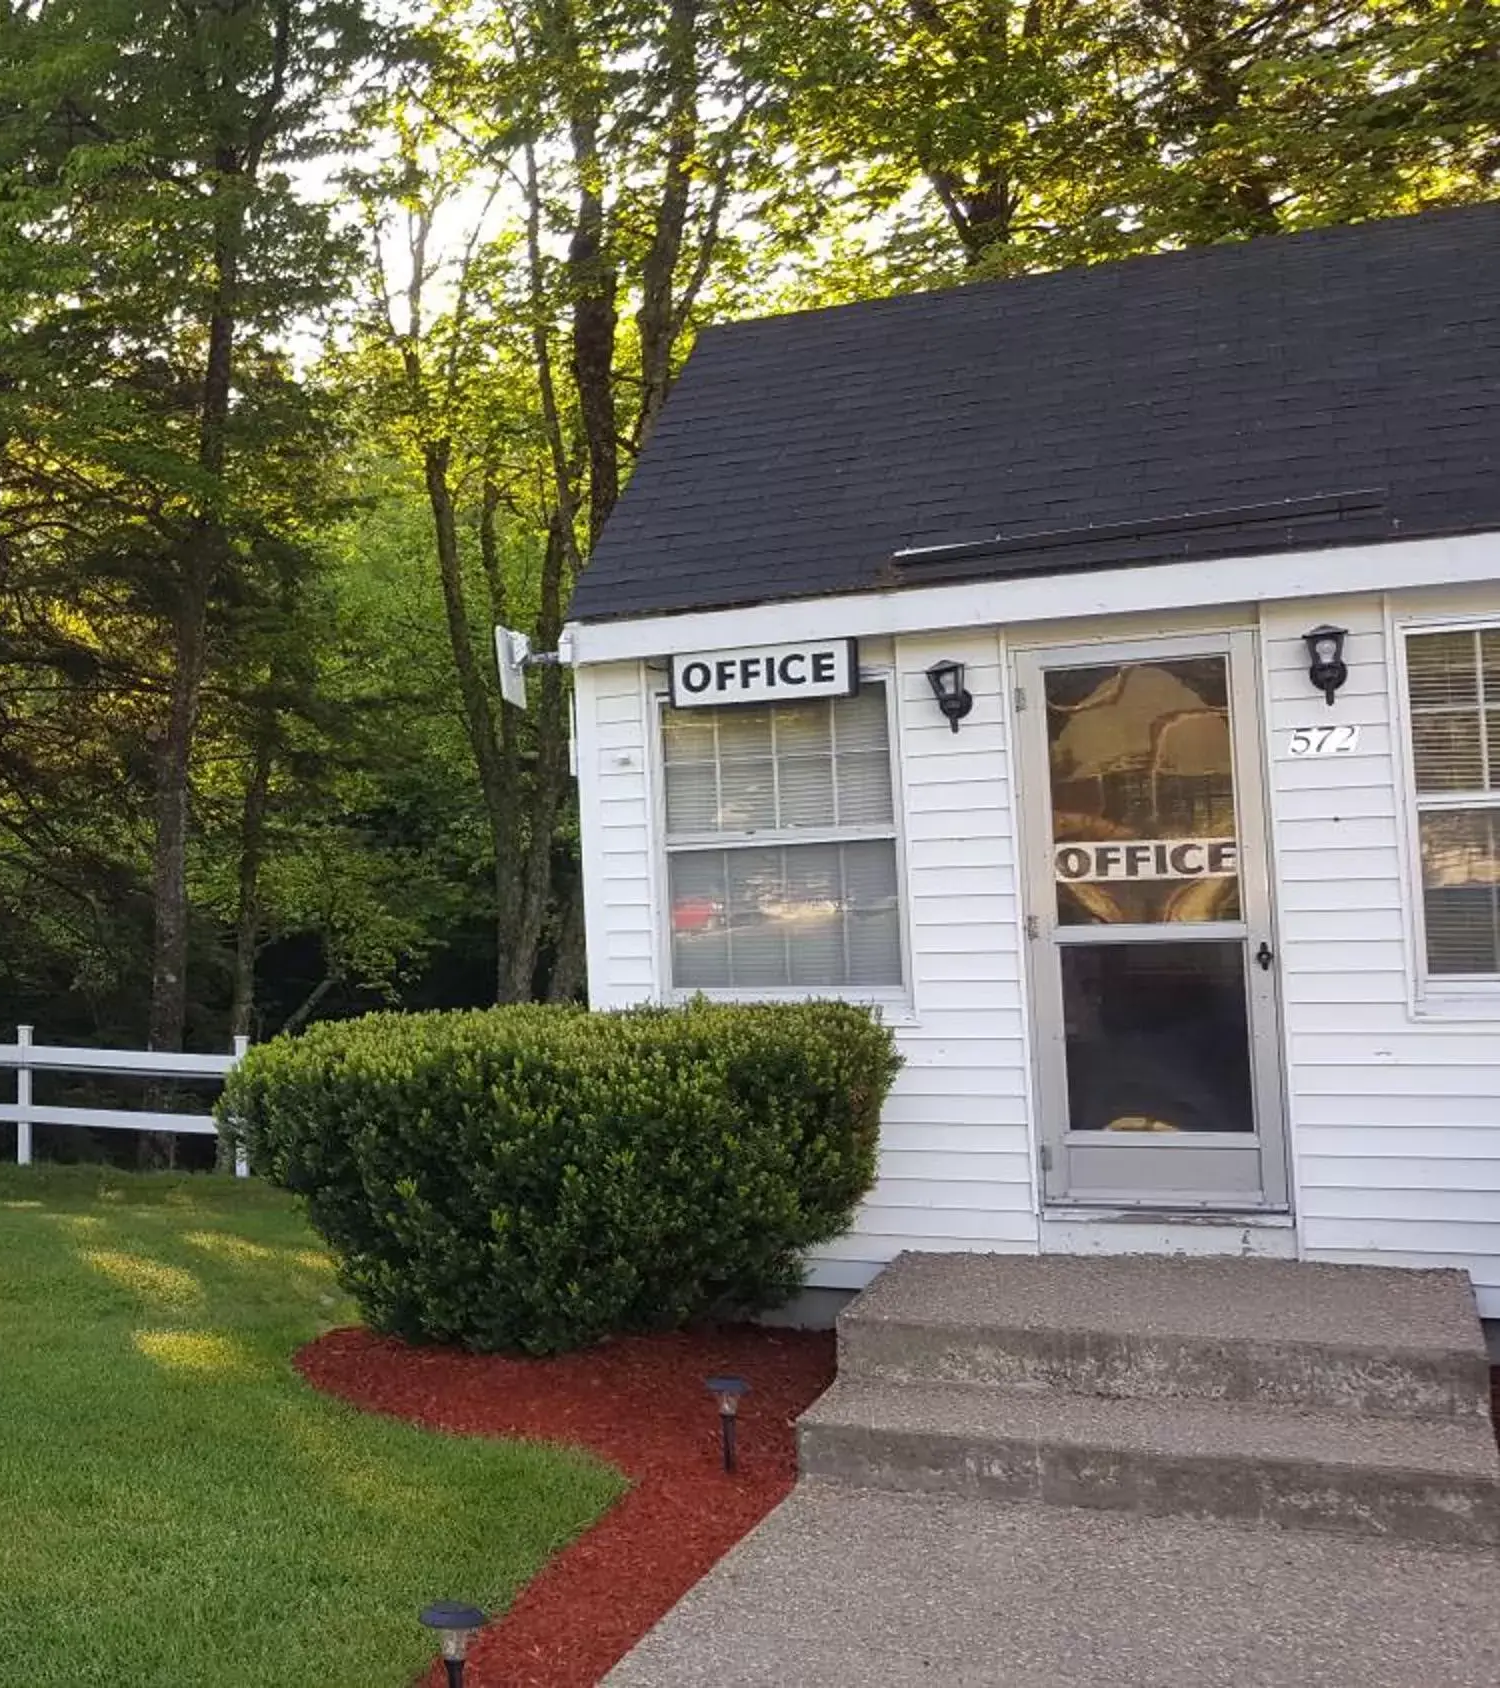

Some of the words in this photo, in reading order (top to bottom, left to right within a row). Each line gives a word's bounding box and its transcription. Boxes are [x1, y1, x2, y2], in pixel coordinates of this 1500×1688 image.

[682, 652, 835, 693] OFFICE
[1291, 725, 1355, 754] 572
[1055, 842, 1237, 878] OFFICE
